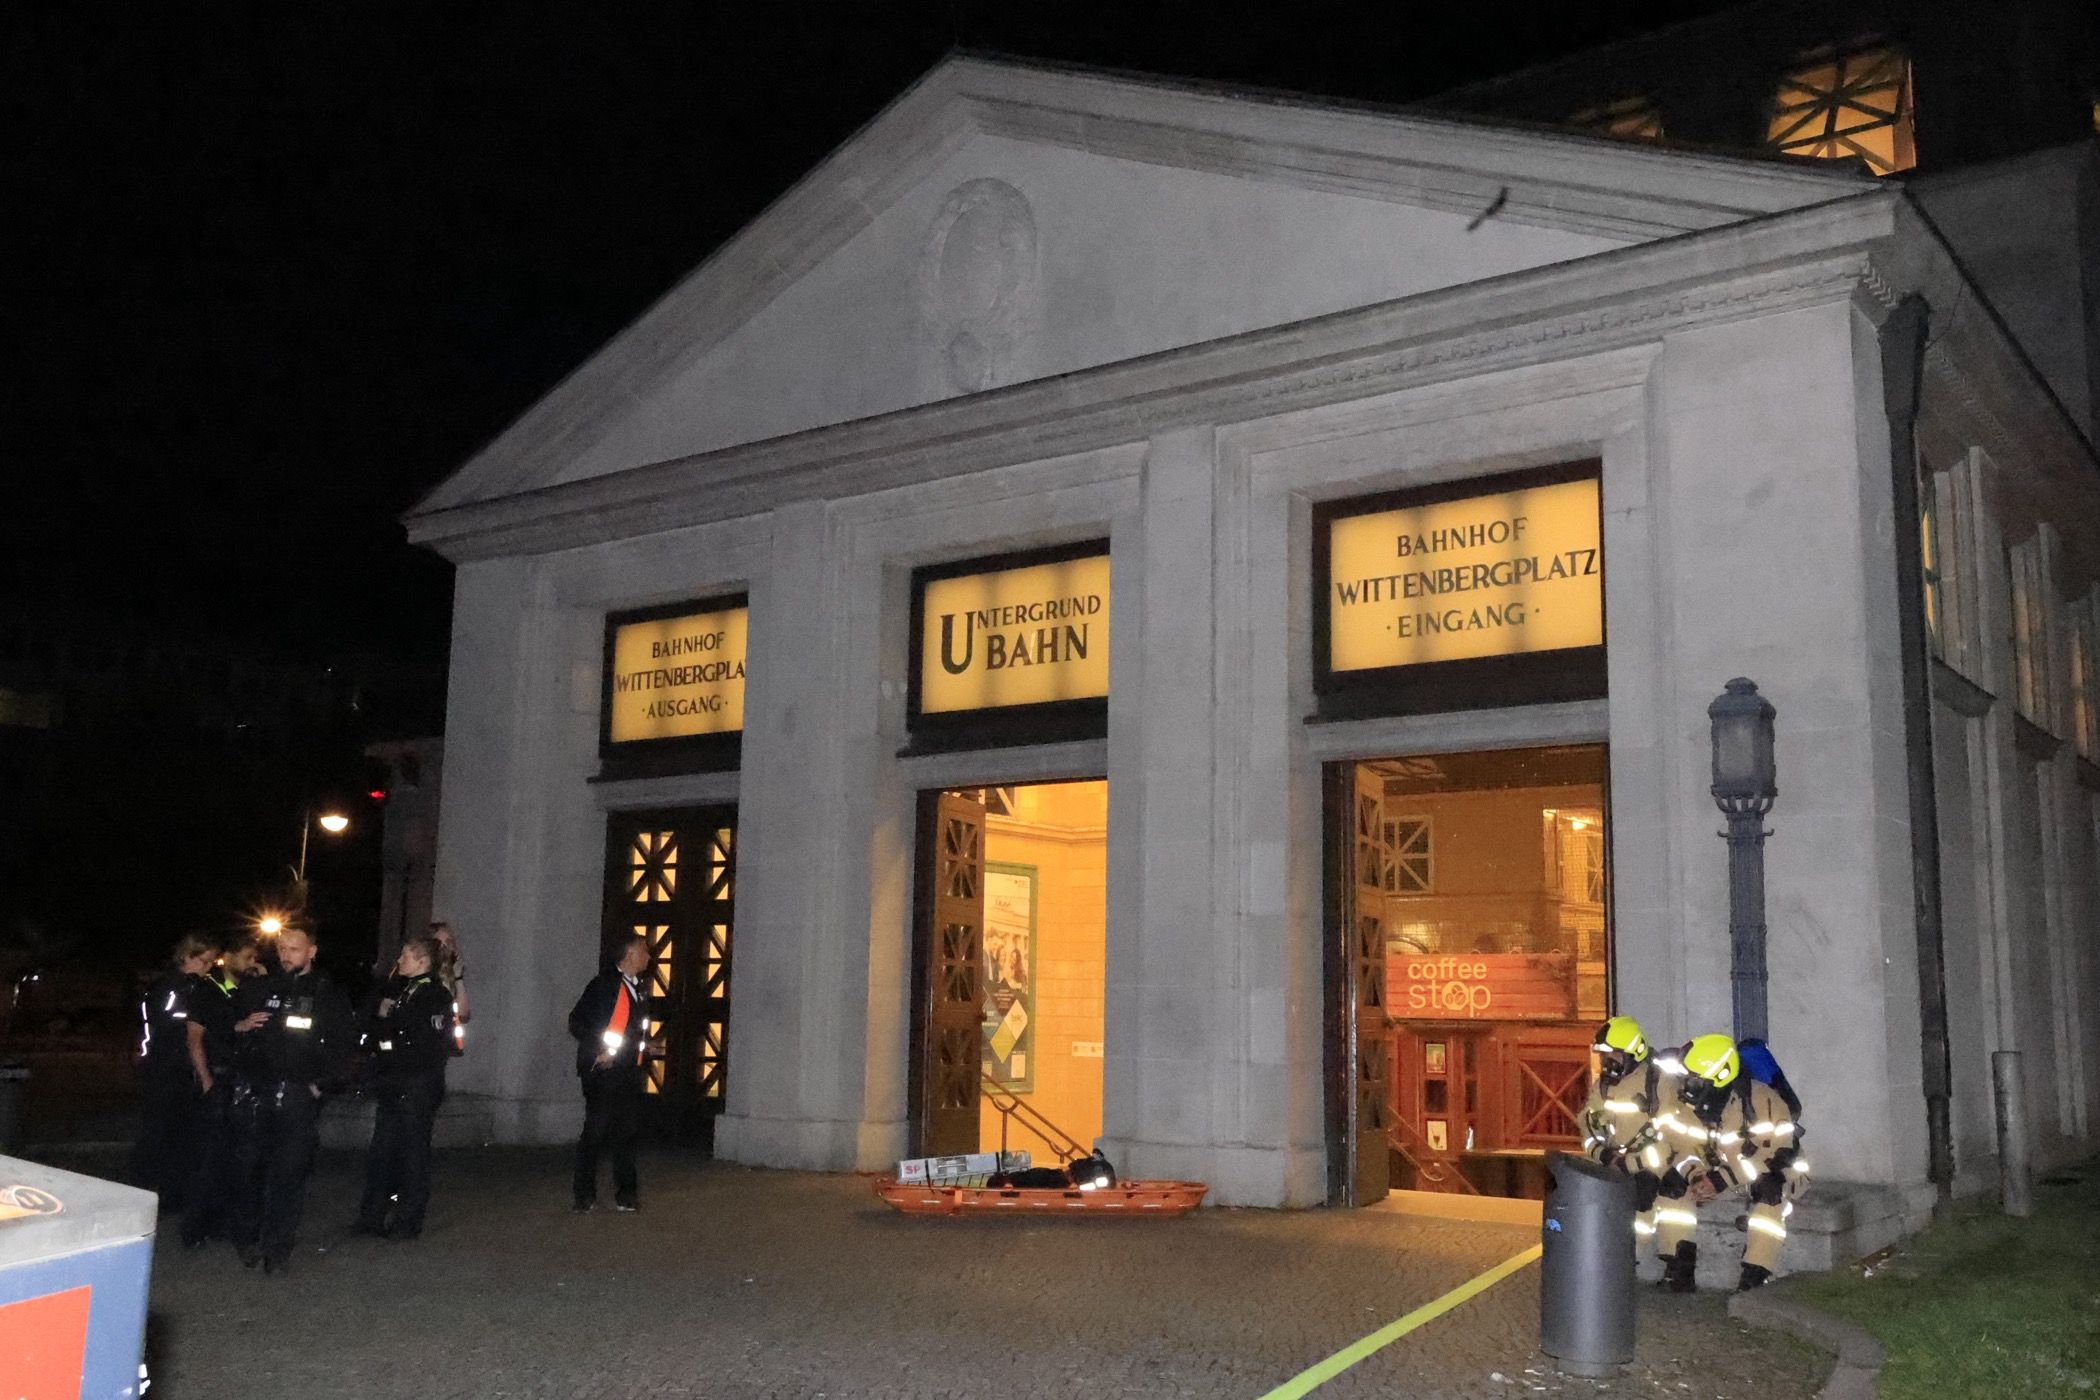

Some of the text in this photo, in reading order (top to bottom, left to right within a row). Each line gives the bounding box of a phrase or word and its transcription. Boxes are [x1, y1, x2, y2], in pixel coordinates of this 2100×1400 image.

[1397, 517, 1527, 557] BAHNHOF
[1336, 549, 1598, 606] WITTENBERGPLATZ
[652, 632, 725, 658] BAHNHOF
[940, 595, 1100, 674] UNTERGRUND
[986, 623, 1088, 670] BAHN
[616, 660, 745, 692] WITTENBERGPLA
[1408, 958, 1488, 980] coffee
[1408, 980, 1491, 1017] stop
